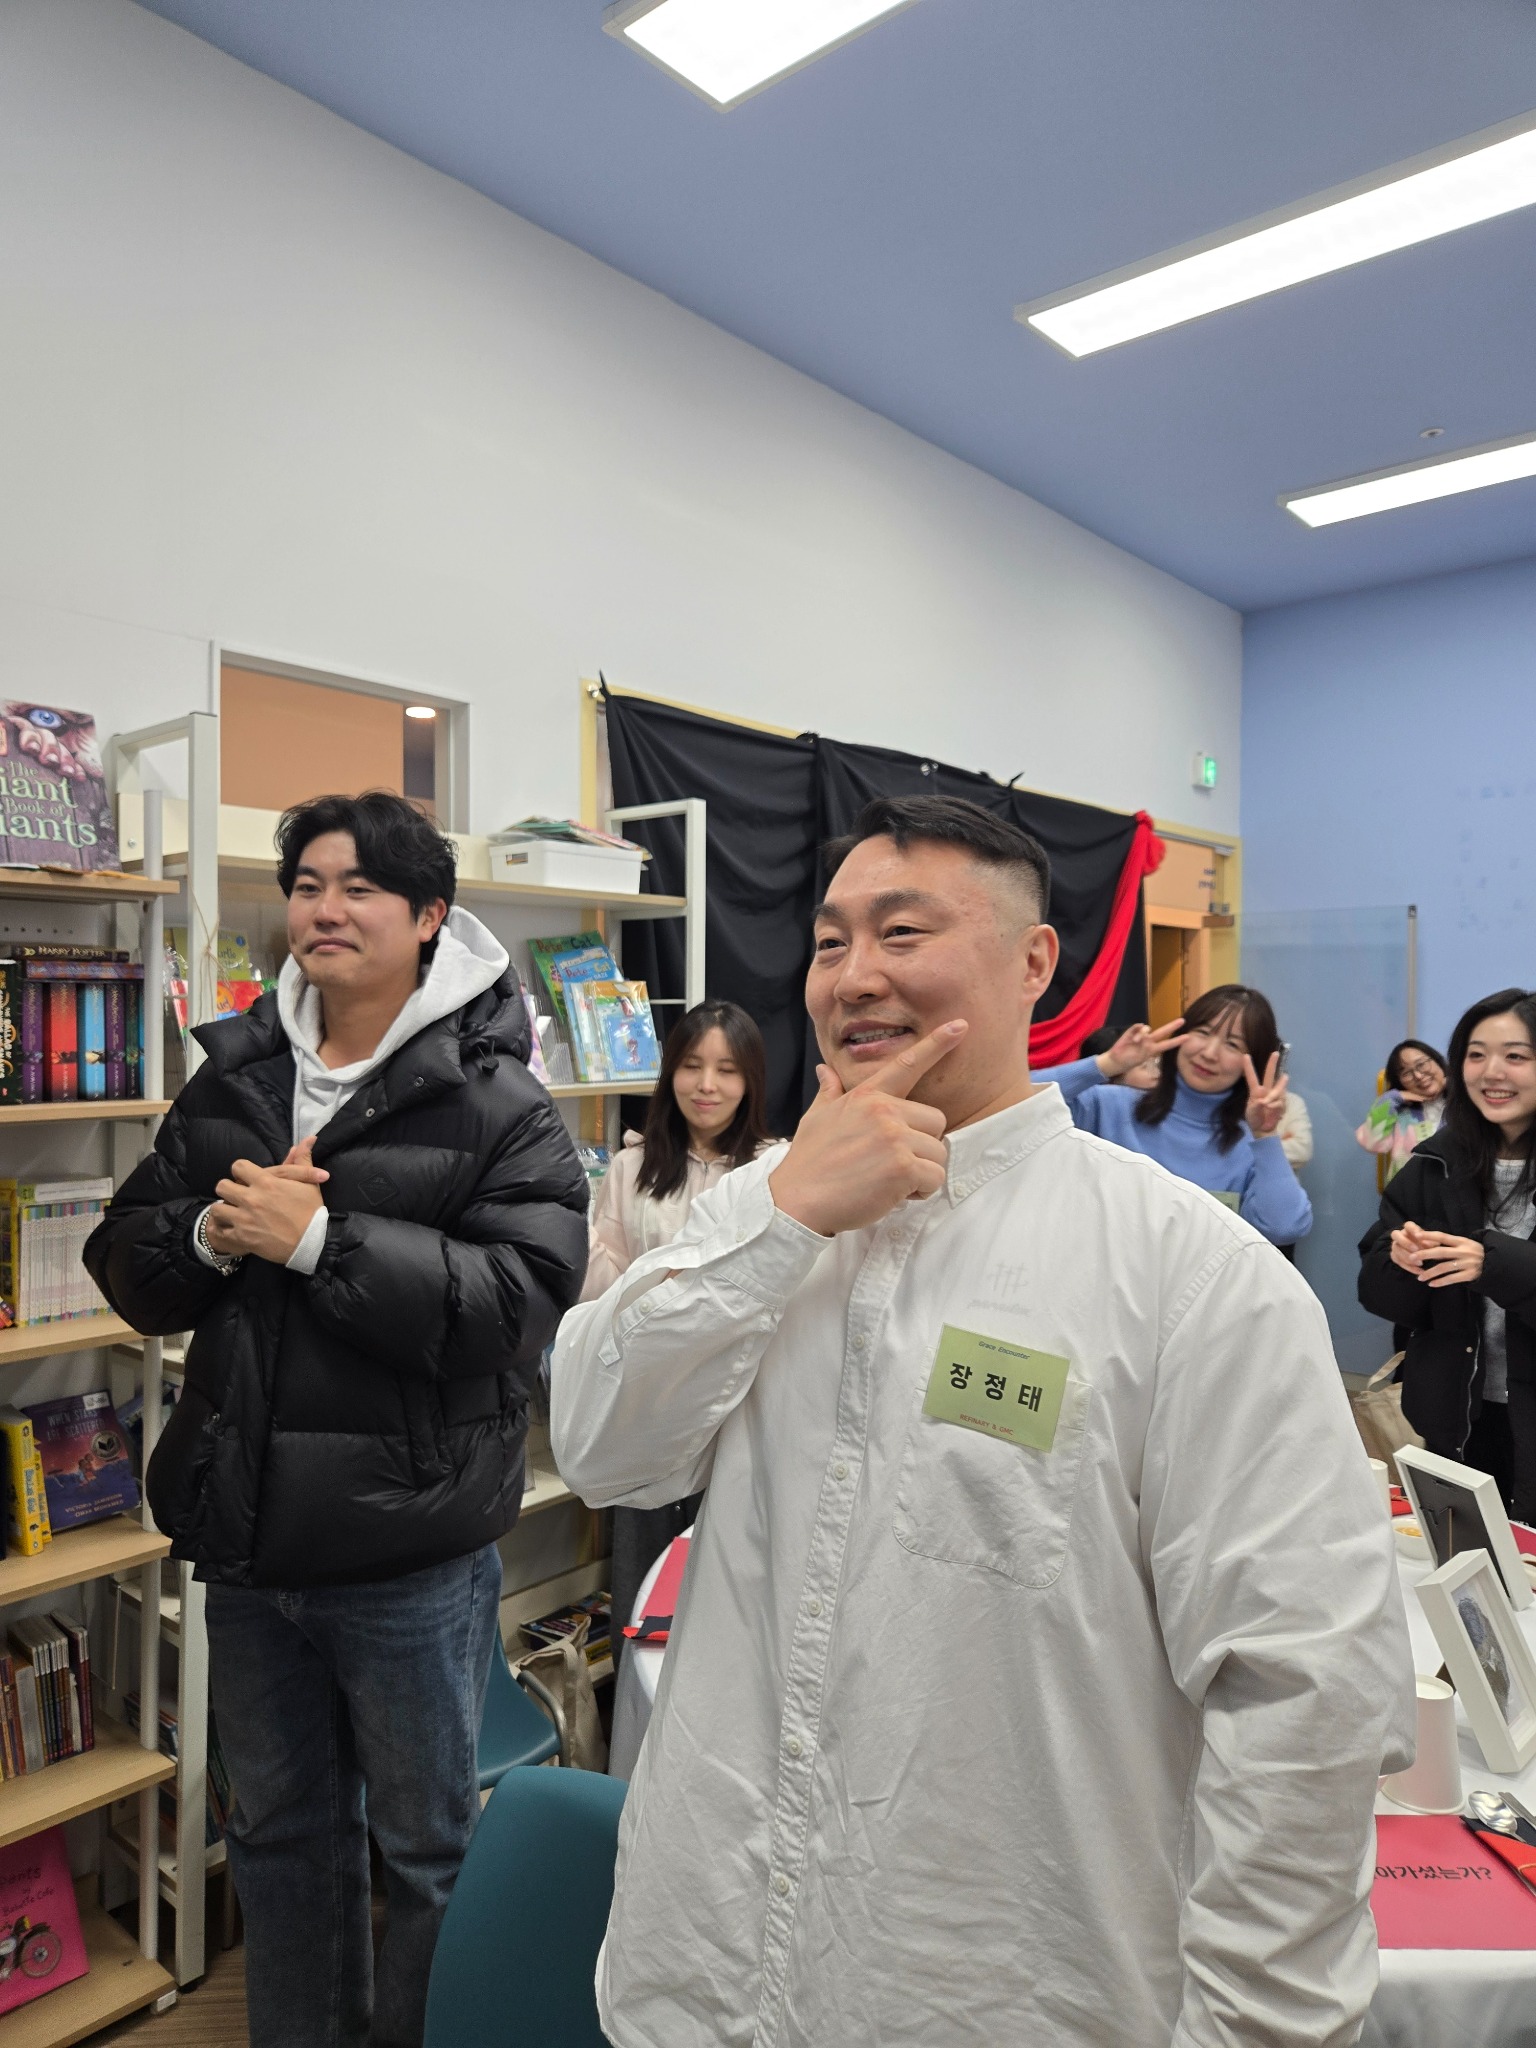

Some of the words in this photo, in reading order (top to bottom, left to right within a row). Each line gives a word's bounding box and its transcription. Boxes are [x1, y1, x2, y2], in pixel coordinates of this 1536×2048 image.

[9, 760, 38, 776] The
[0, 767, 78, 809] iant
[5, 798, 45, 814] Book
[50, 803, 66, 817] of
[0, 803, 98, 848] iants
[38, 946, 71, 956] HARRY
[72, 947, 107, 957] POTTER
[978, 1340, 996, 1351] Grace
[997, 1346, 1031, 1360] Encounter
[950, 1362, 973, 1390] 장
[985, 1372, 1007, 1401] 정
[1017, 1384, 1043, 1413] 태
[959, 1413, 990, 1427] REFINARY
[999, 1426, 1014, 1436] GMC
[1374, 1865, 1493, 1881] 아가셨는가?
